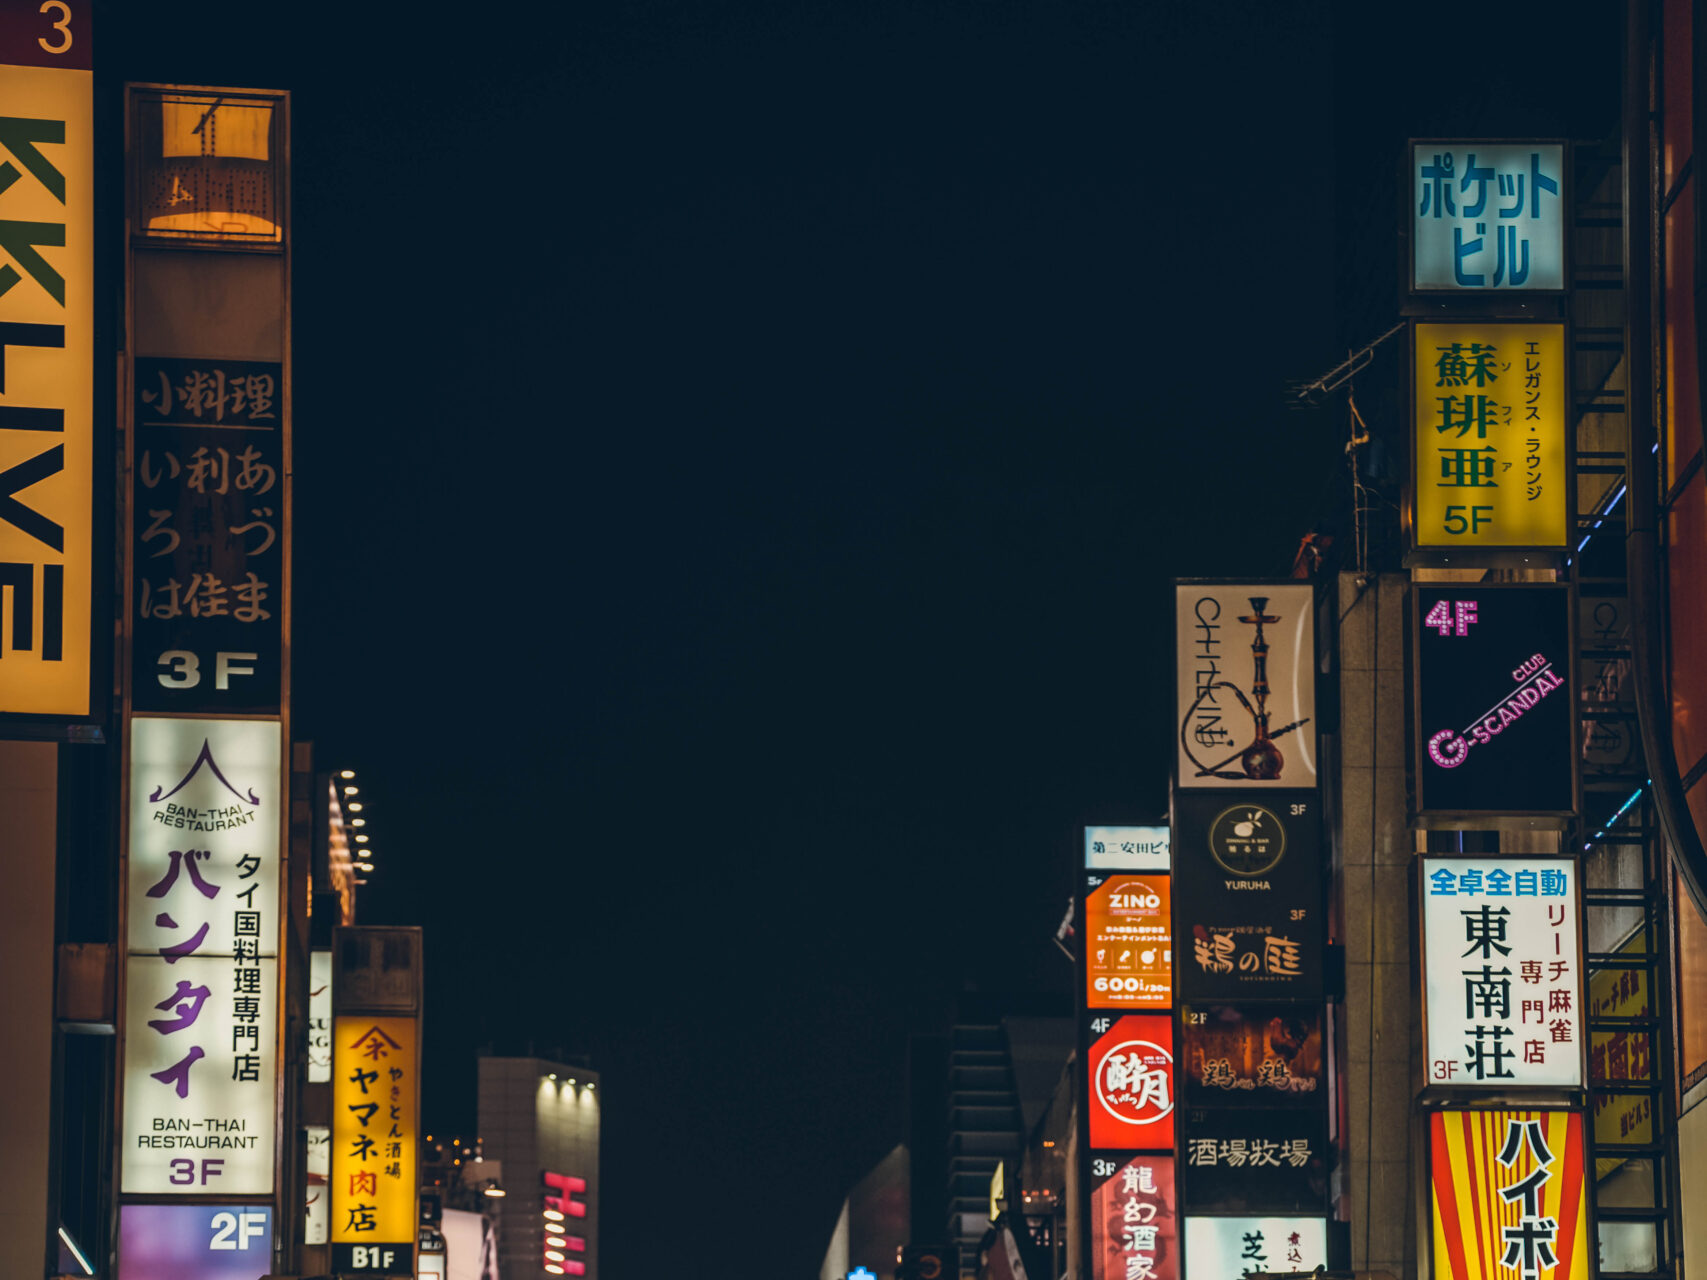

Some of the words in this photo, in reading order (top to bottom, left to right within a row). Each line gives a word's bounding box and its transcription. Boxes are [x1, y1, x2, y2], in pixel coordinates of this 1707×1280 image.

[1420, 152, 1558, 219] ポケット
[1453, 223, 1529, 288] ビル
[142, 369, 275, 421] 小料理
[1524, 341, 1543, 501] エレガンス・ラウンジ
[1443, 505, 1493, 535] 5F
[1425, 600, 1478, 636] 4F
[157, 650, 258, 690] 3F
[1512, 653, 1545, 682] CLUB
[1428, 671, 1564, 768] G-SCANDAL
[153, 809, 257, 833] RESTAURANT
[166, 802, 242, 820] BAN-THAI
[1290, 805, 1306, 815] 3F
[1225, 880, 1271, 890] YURUHA
[1430, 869, 1567, 897] 全卓全自動
[1109, 894, 1161, 908] ZINO
[1290, 910, 1306, 920] 3F
[145, 849, 221, 1099] バンタイ
[231, 854, 262, 1083] タイ国料理専門店
[1549, 905, 1573, 1043] リーチ麻雀
[1460, 905, 1515, 1080] 東南荘
[1090, 1018, 1110, 1033] 4F
[1190, 1013, 1208, 1024] 2F
[1520, 961, 1545, 1064] 専門店
[1433, 1061, 1458, 1080] 3F
[152, 1118, 245, 1132] BAN-THAI
[385, 1066, 404, 1179] やきとん酒場
[138, 1135, 258, 1149] RESTAURANT
[344, 1068, 378, 1233] ヤマネ肉店
[1189, 1138, 1313, 1167] 酒場牧場
[169, 1159, 225, 1185] 3F
[1093, 1159, 1116, 1177] 3F
[210, 1212, 267, 1251] 2F
[352, 1245, 394, 1269] B1F
